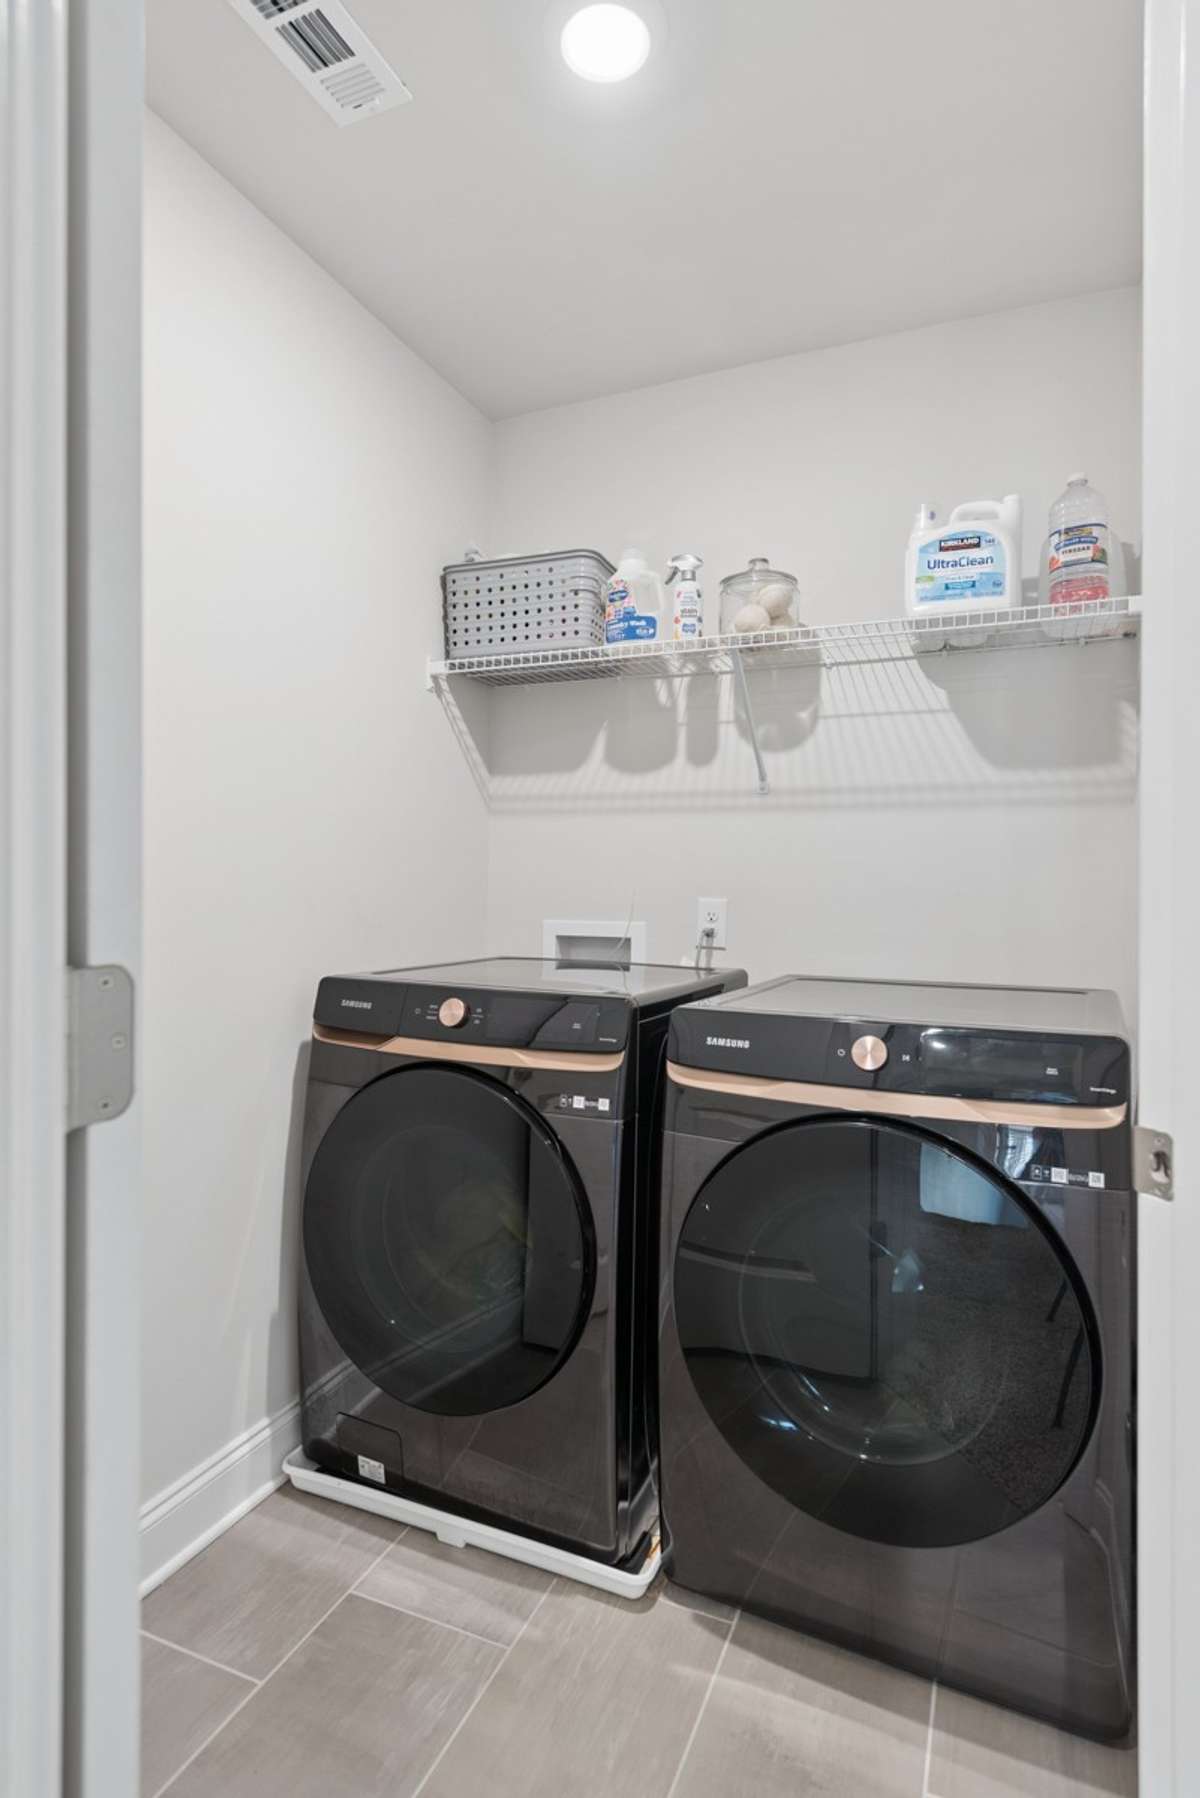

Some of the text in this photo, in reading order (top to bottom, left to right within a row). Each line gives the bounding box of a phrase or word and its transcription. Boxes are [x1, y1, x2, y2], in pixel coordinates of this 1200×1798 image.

[927, 555, 995, 570] UltraClean
[341, 998, 372, 1010] SAMSUNG
[706, 1036, 750, 1049] SAMSUNG
